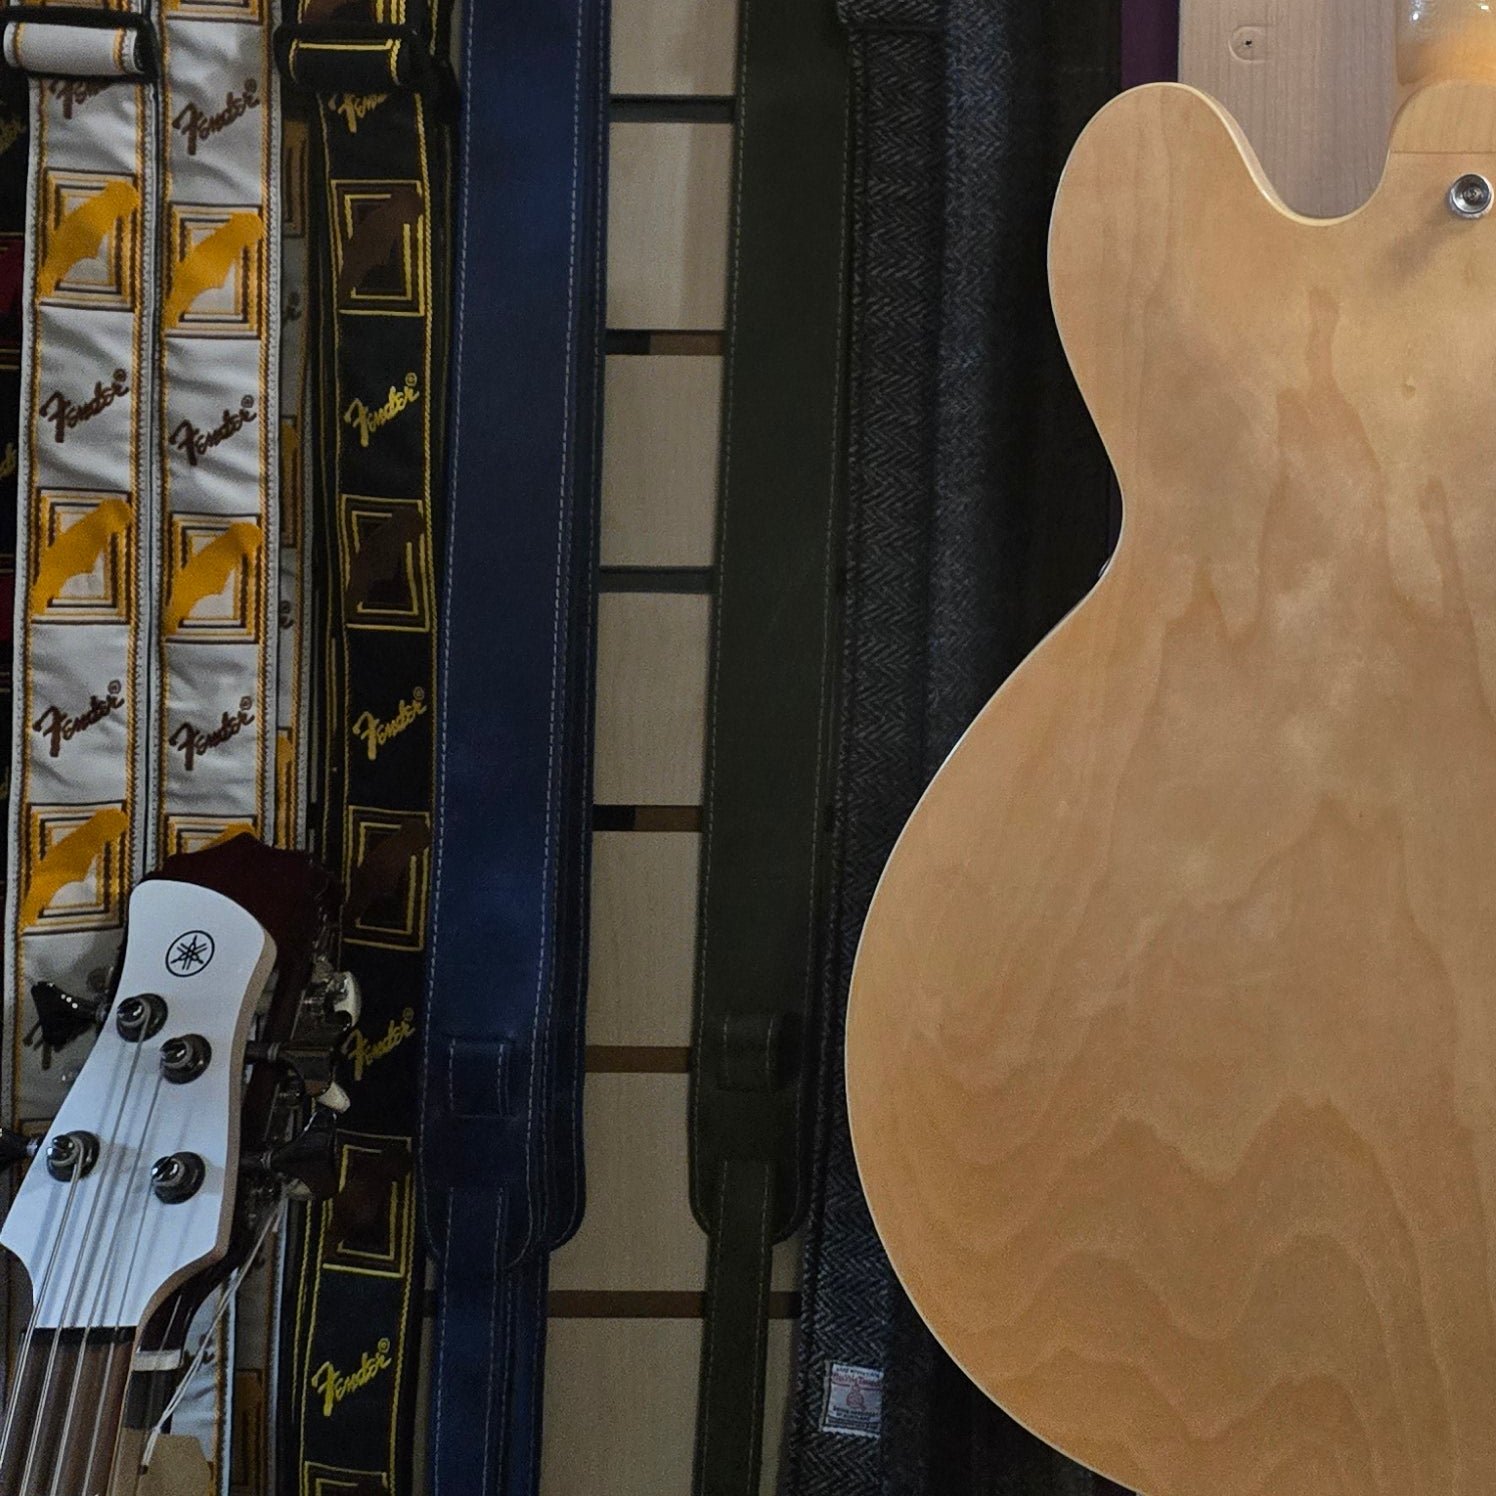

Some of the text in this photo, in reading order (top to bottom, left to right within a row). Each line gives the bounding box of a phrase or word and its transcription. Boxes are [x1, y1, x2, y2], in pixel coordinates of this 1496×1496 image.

[172, 90, 260, 155] Fender
[40, 377, 130, 442] Fender
[169, 401, 257, 465] Fender
[344, 384, 419, 447] Fender
[33, 693, 125, 758] Fender
[169, 706, 256, 771] Fender
[352, 698, 426, 760] Fender
[311, 1350, 392, 1416] Fender
